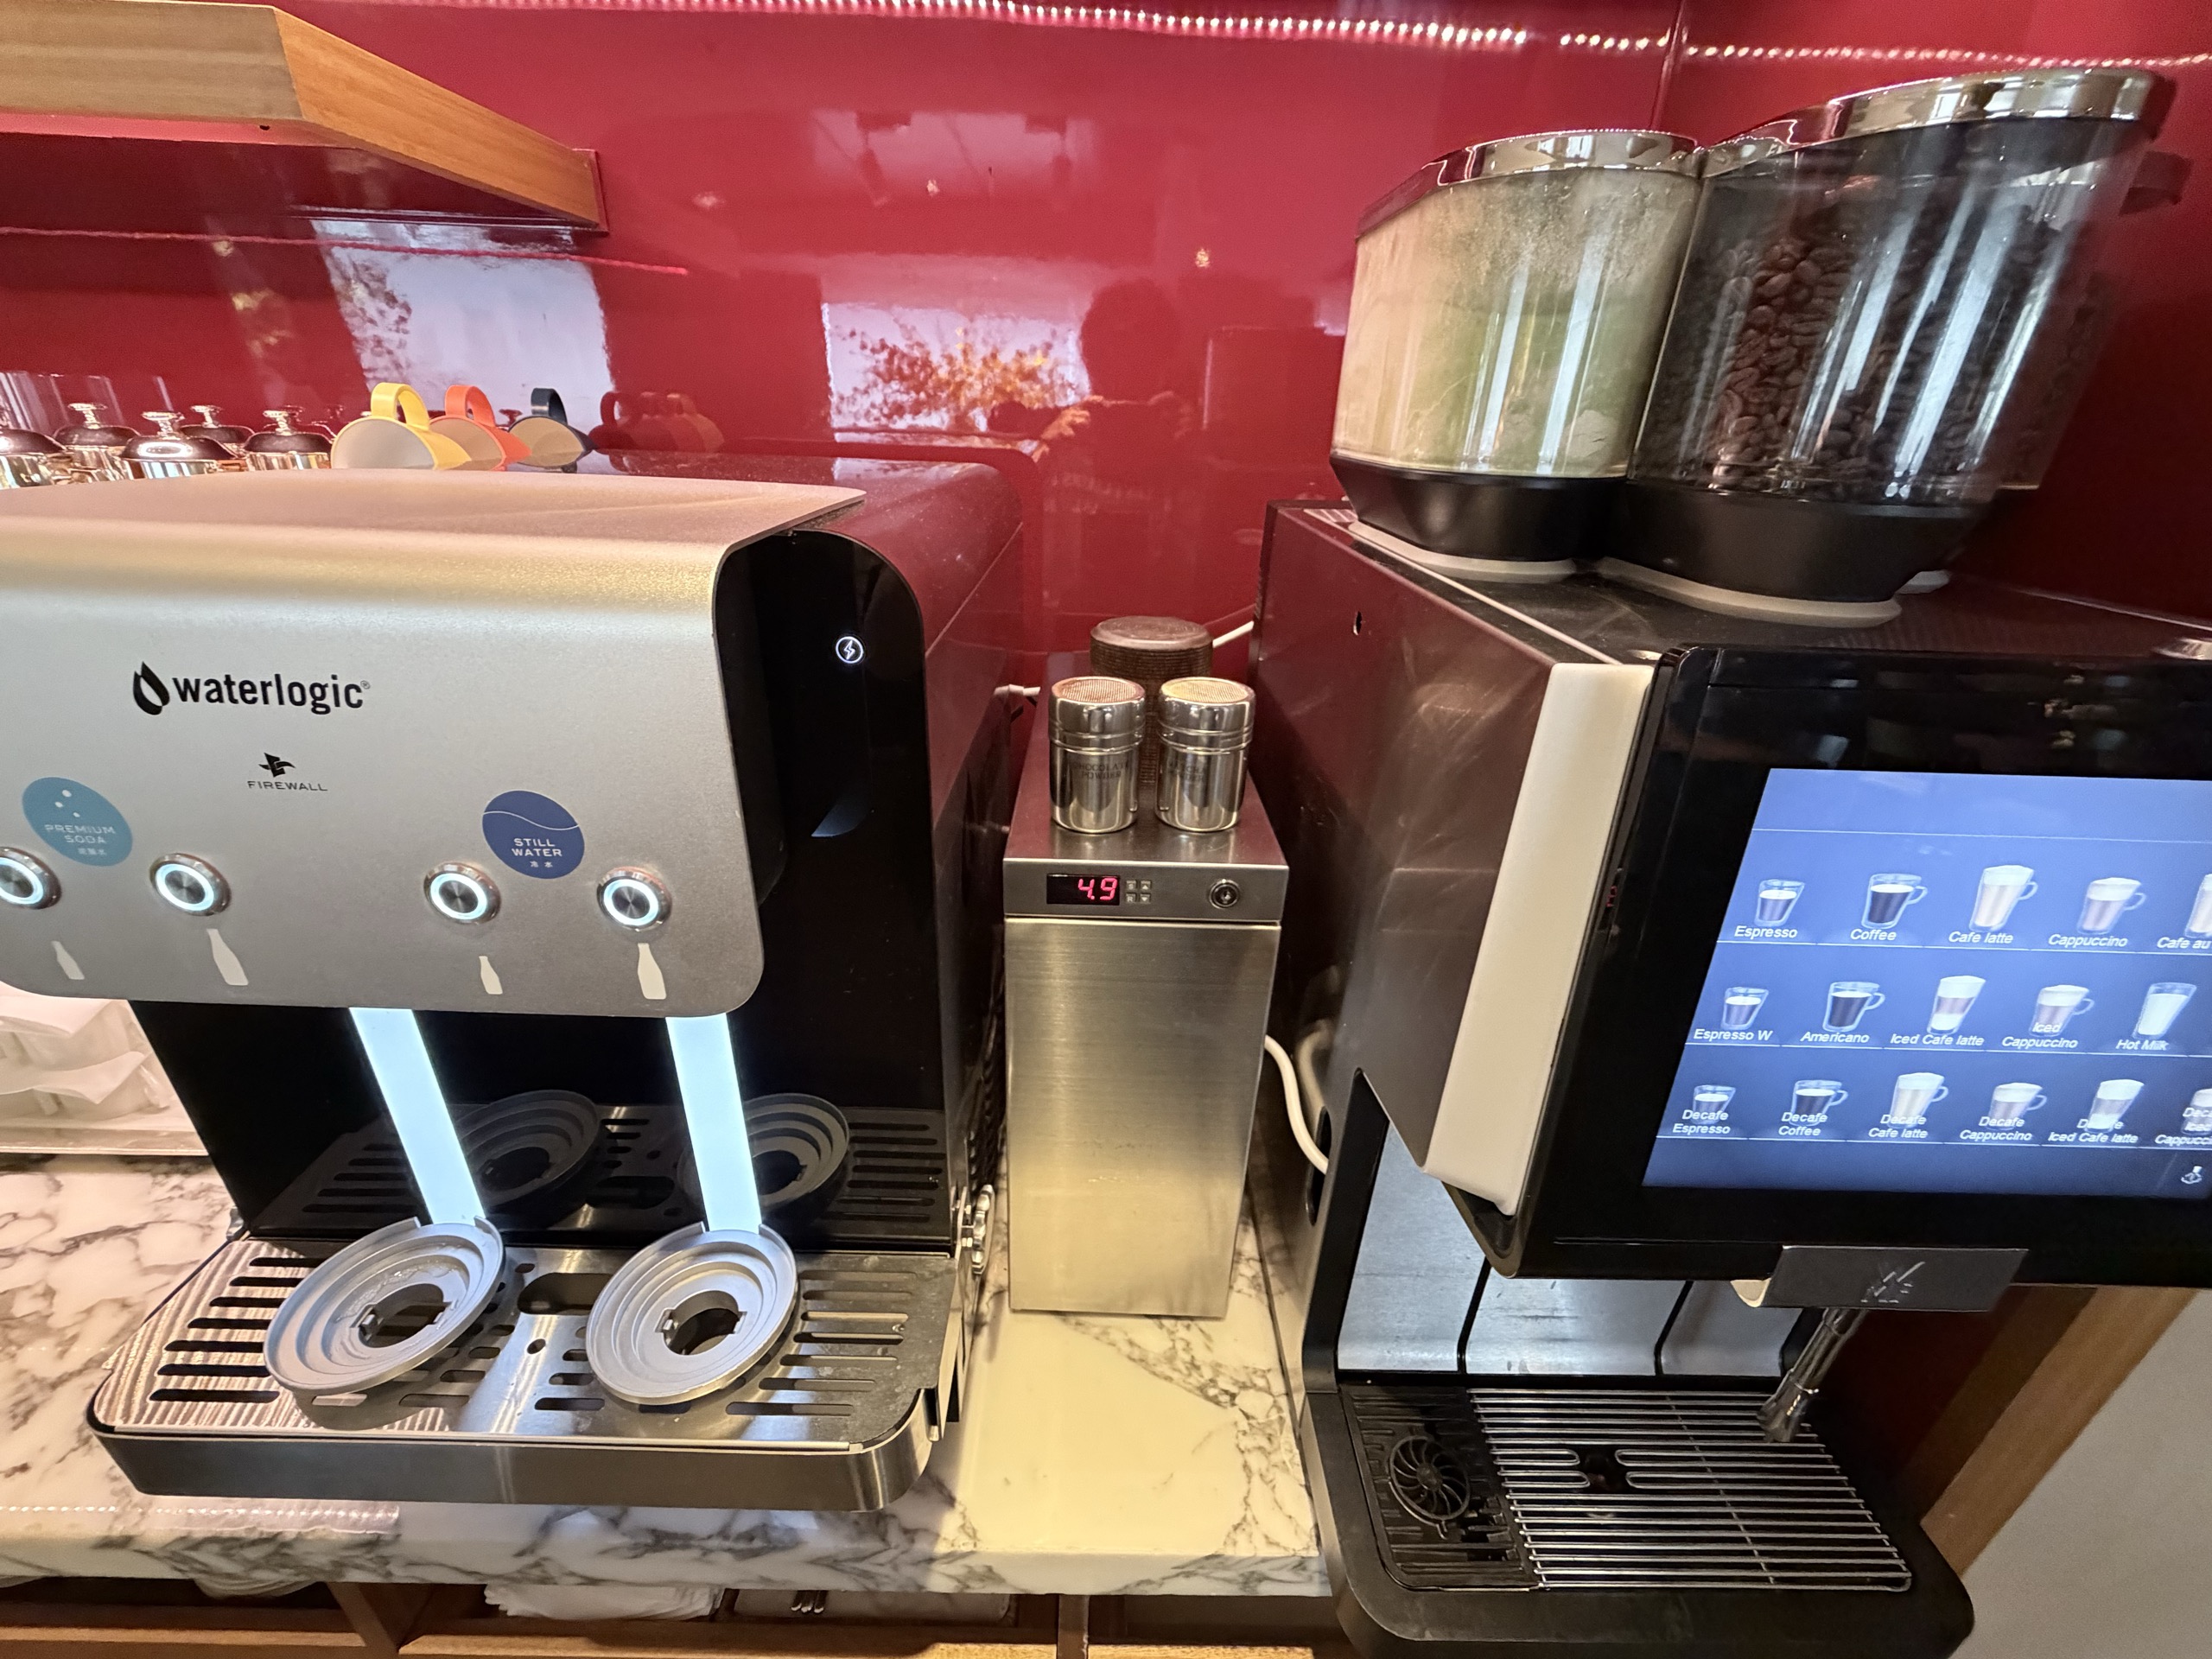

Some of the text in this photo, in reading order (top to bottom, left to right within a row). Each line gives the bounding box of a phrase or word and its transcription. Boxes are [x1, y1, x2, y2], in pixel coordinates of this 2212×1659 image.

[247, 780, 328, 791] FIREWALL
[44, 823, 116, 834] PREMIUM
[64, 835, 106, 843] SODA
[513, 837, 556, 847] STILL
[512, 848, 563, 856] WATER
[1077, 877, 1117, 900] 4.9
[1734, 925, 1798, 939] Espresso
[1850, 928, 1897, 941] Coffee
[1948, 931, 2013, 944] Cafe latte
[2048, 934, 2127, 949] Cappuccino
[2157, 937, 2212, 949] Cafe au
[2032, 1023, 2061, 1033] Iced
[1694, 1028, 1774, 1042] Espresso W
[1801, 1031, 1870, 1044] Americano
[1890, 1033, 1985, 1046] Iced Cafe latte
[2002, 1036, 2078, 1050] Cappuccino
[2115, 1039, 2140, 1050] Hot
[1681, 1109, 1729, 1121] Decafe
[1781, 1111, 1827, 1123] Decafe
[1880, 1114, 1927, 1125] Decafe
[1978, 1116, 2025, 1128] Decafe
[1672, 1123, 1731, 1136] Espresso
[1778, 1125, 1821, 1136] Coffee
[1868, 1128, 1929, 1139] Cafe latte
[1960, 1129, 2032, 1142] Cappuccino
[2048, 1131, 2139, 1143] Iced Cafe latte
